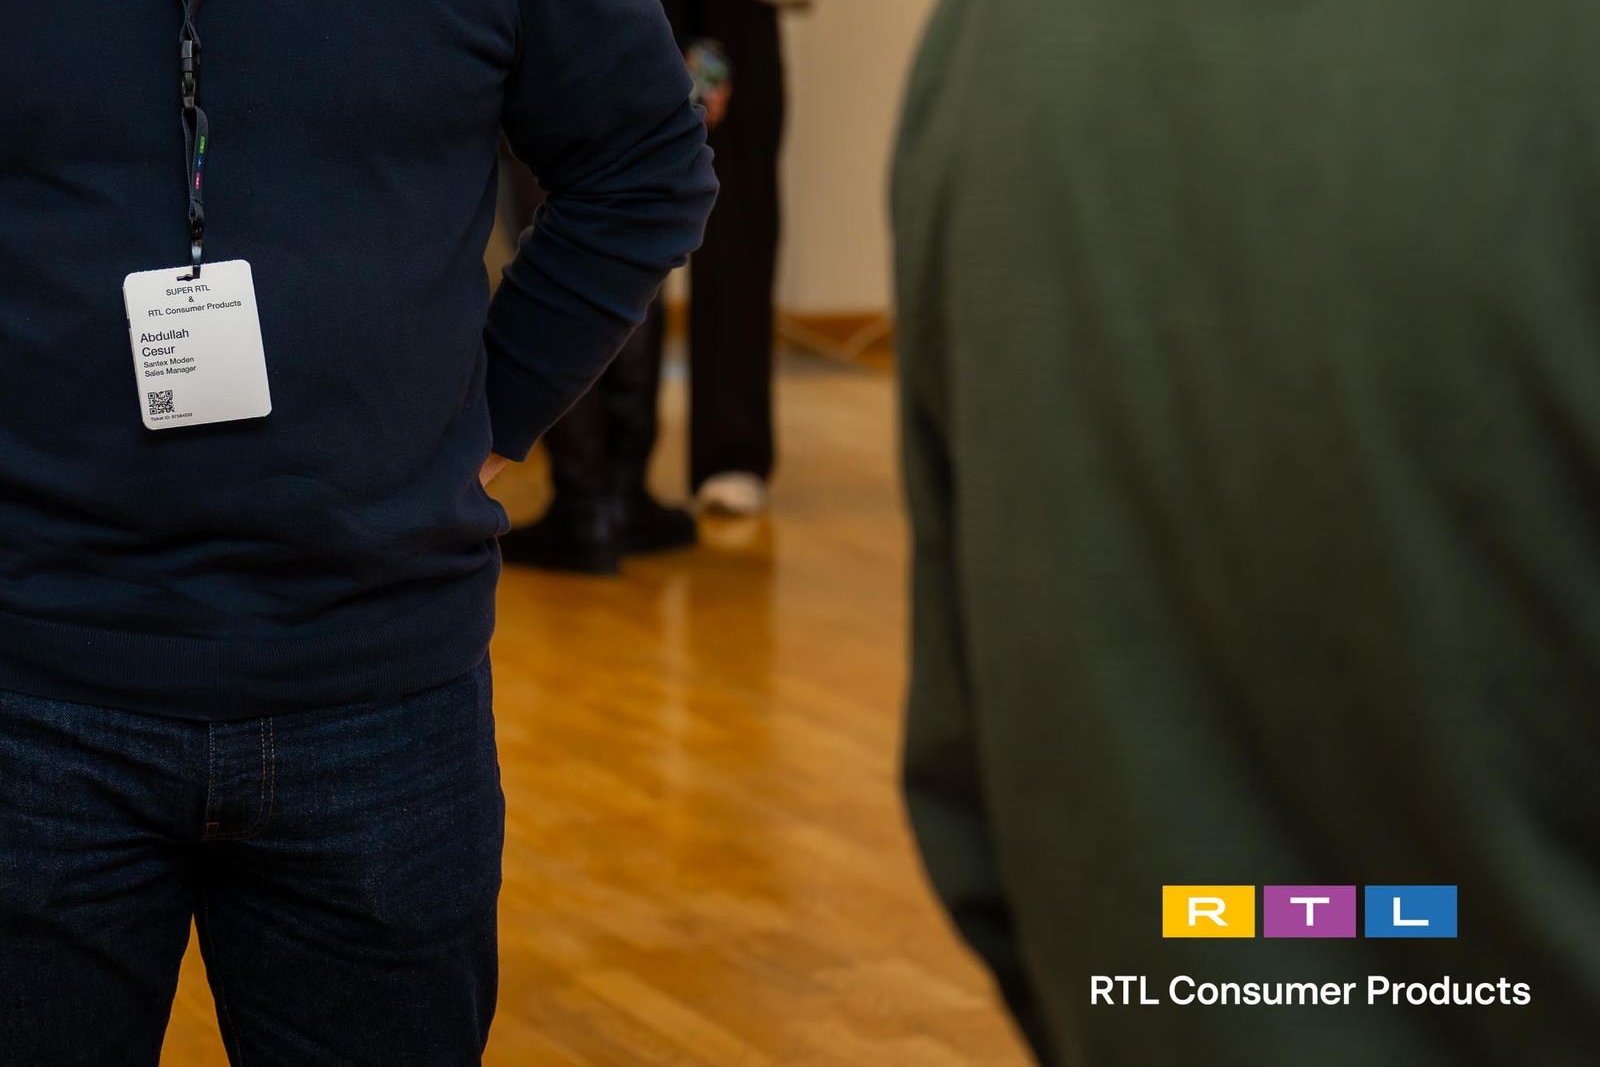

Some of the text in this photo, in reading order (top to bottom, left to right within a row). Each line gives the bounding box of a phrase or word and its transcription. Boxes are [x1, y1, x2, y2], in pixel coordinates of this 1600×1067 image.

[165, 284, 211, 296] SUPER RTL
[148, 300, 242, 317] RTL Consumer Products
[140, 329, 190, 343] Abdullah
[142, 345, 176, 357] Cesur
[170, 356, 195, 366] Moden
[145, 365, 197, 378] Sales Manager
